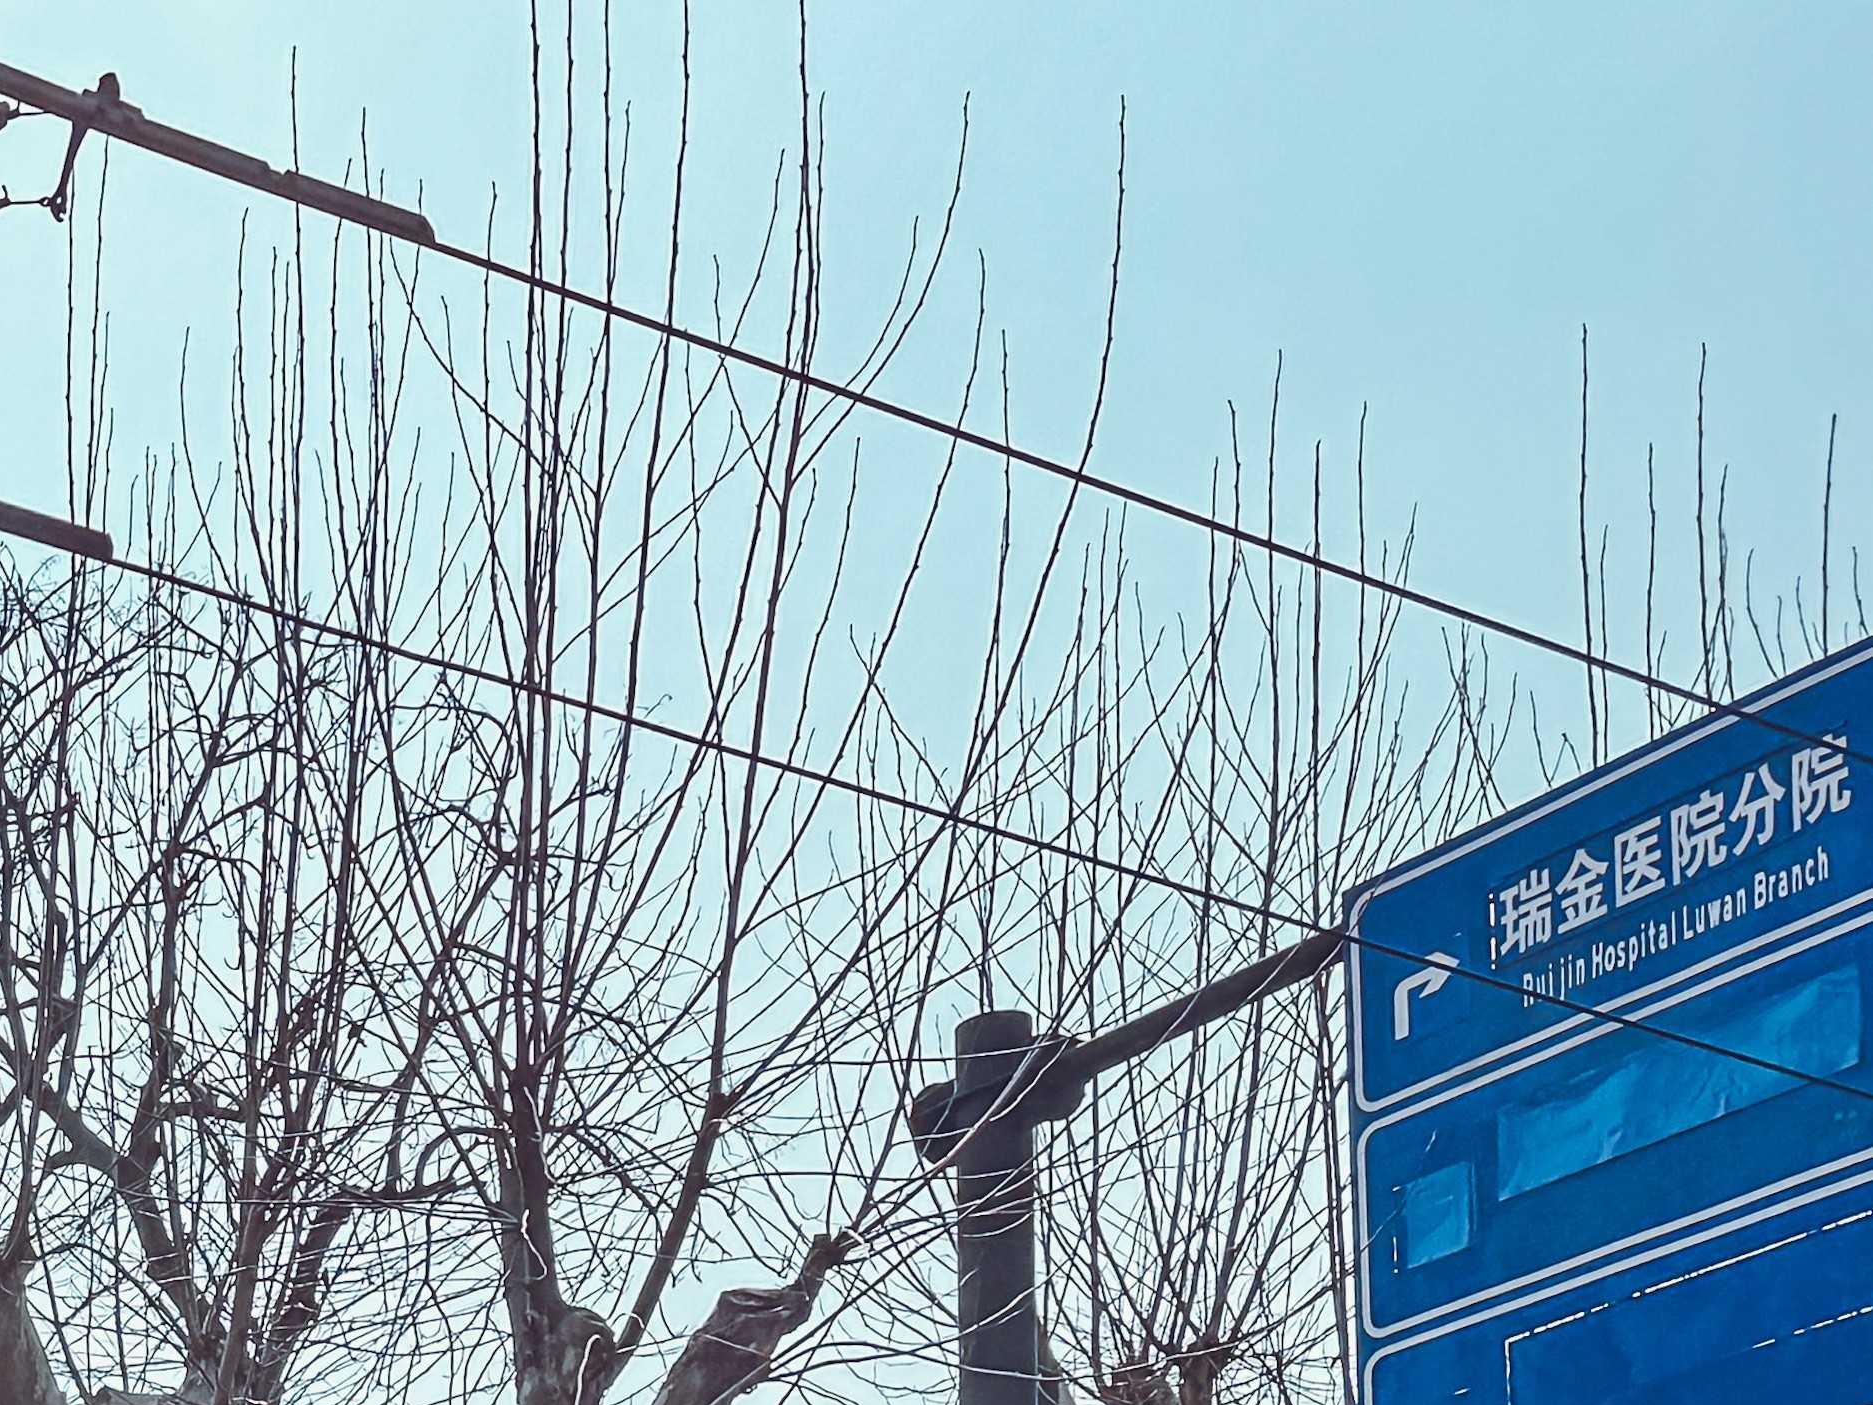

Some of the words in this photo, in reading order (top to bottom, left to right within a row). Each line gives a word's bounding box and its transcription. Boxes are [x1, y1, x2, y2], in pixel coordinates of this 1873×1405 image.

[1499, 734, 1852, 956] 瑞金医院分院
[1592, 911, 1677, 979] Hospital
[1682, 887, 1747, 941] Luwan
[1754, 845, 1830, 910] Branch
